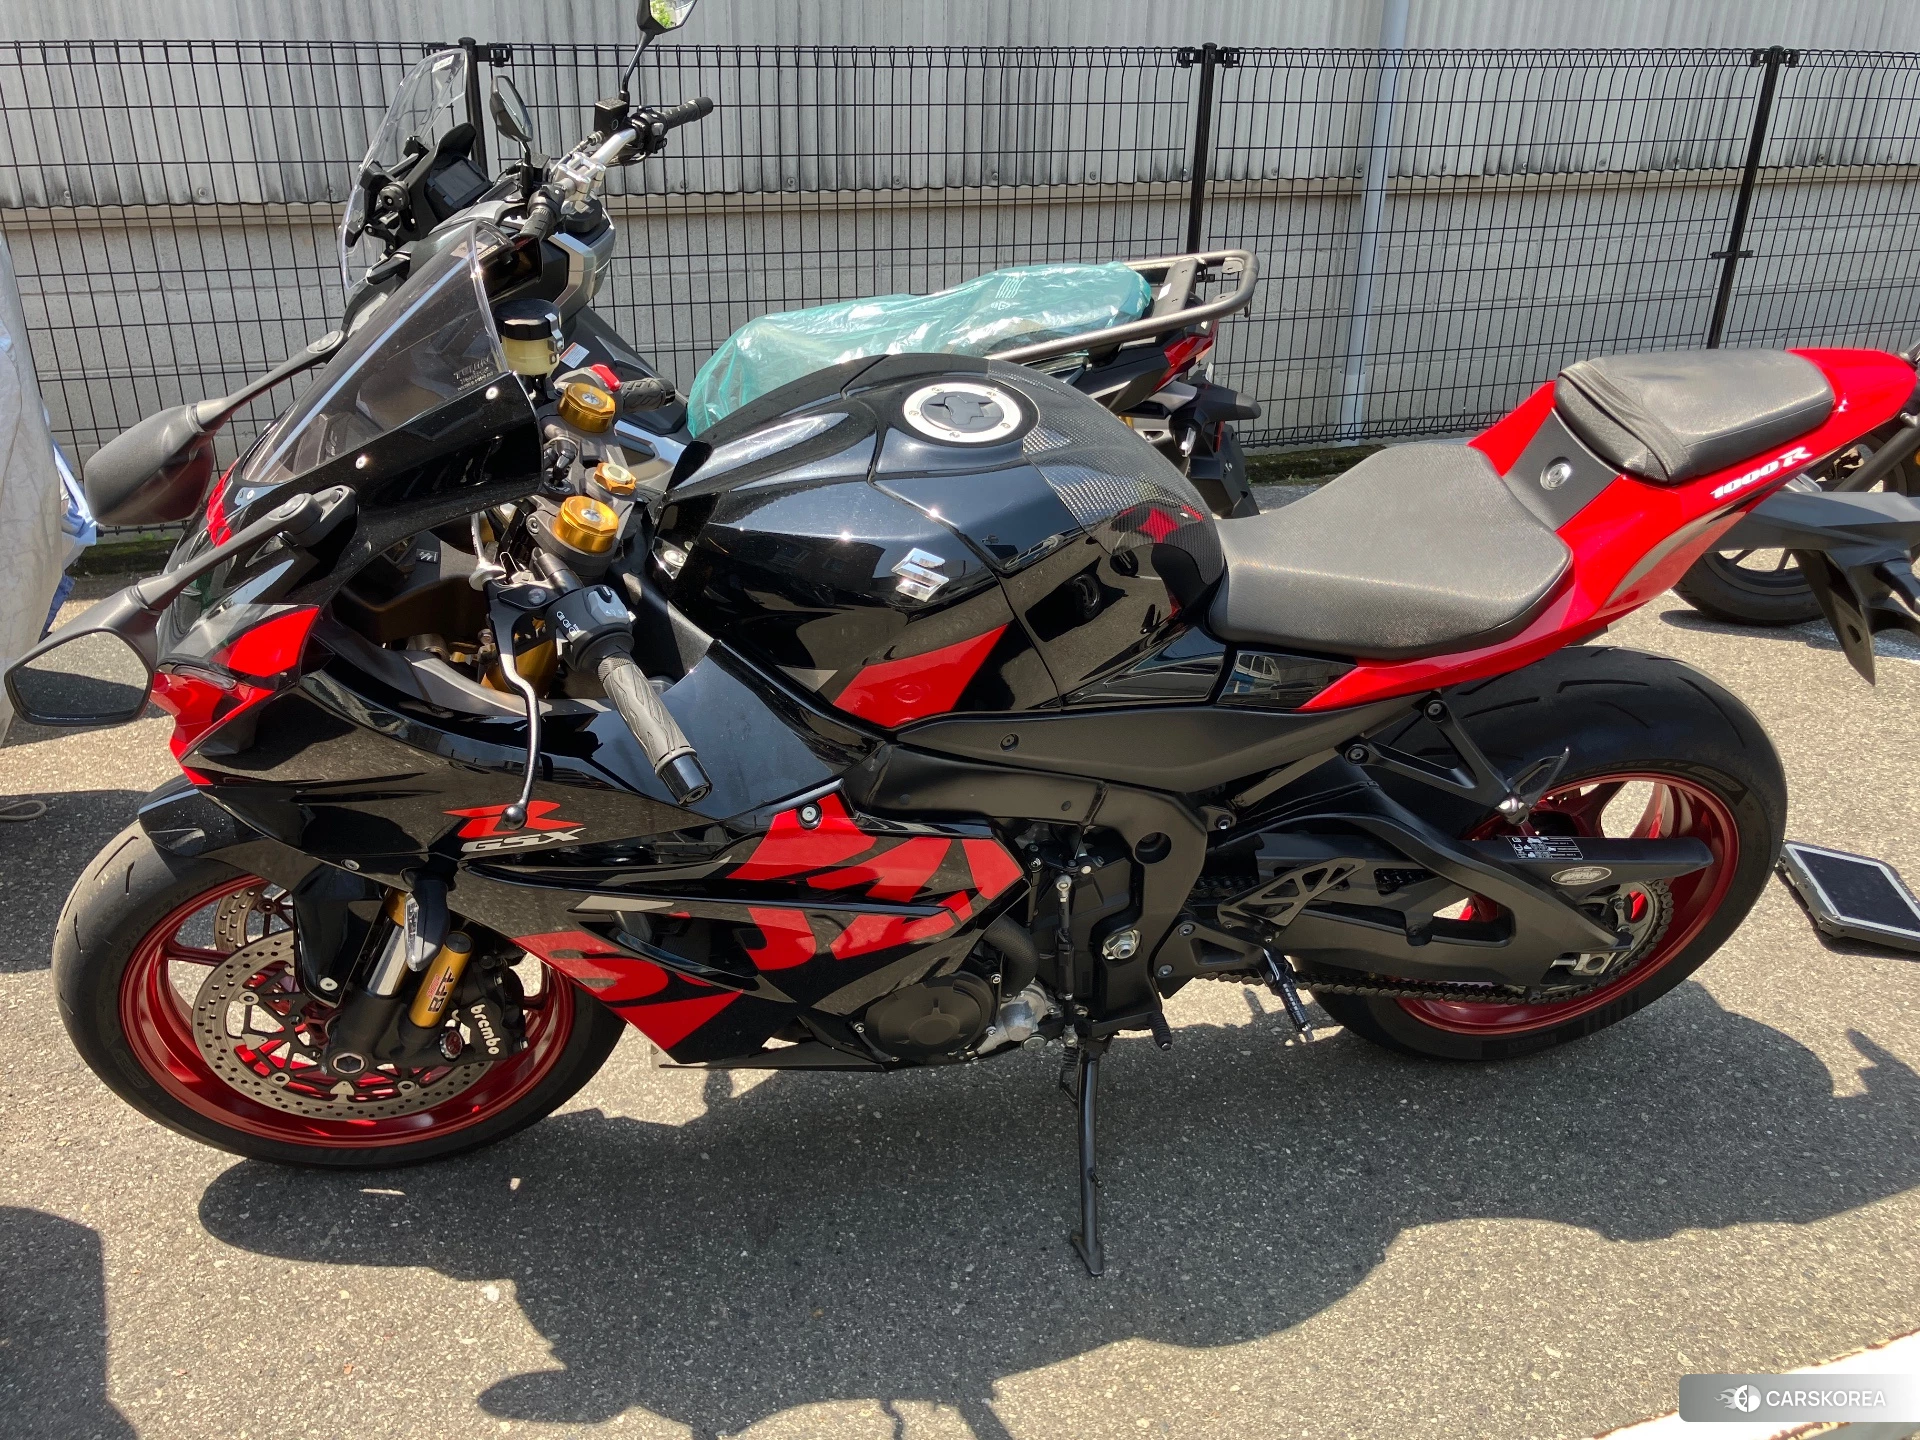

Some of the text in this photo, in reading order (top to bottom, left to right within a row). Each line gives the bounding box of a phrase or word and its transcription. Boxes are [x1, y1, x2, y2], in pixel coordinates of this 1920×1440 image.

[460, 827, 587, 852] GSX
[428, 966, 455, 1013] BFF
[470, 1004, 502, 1055] brembo
